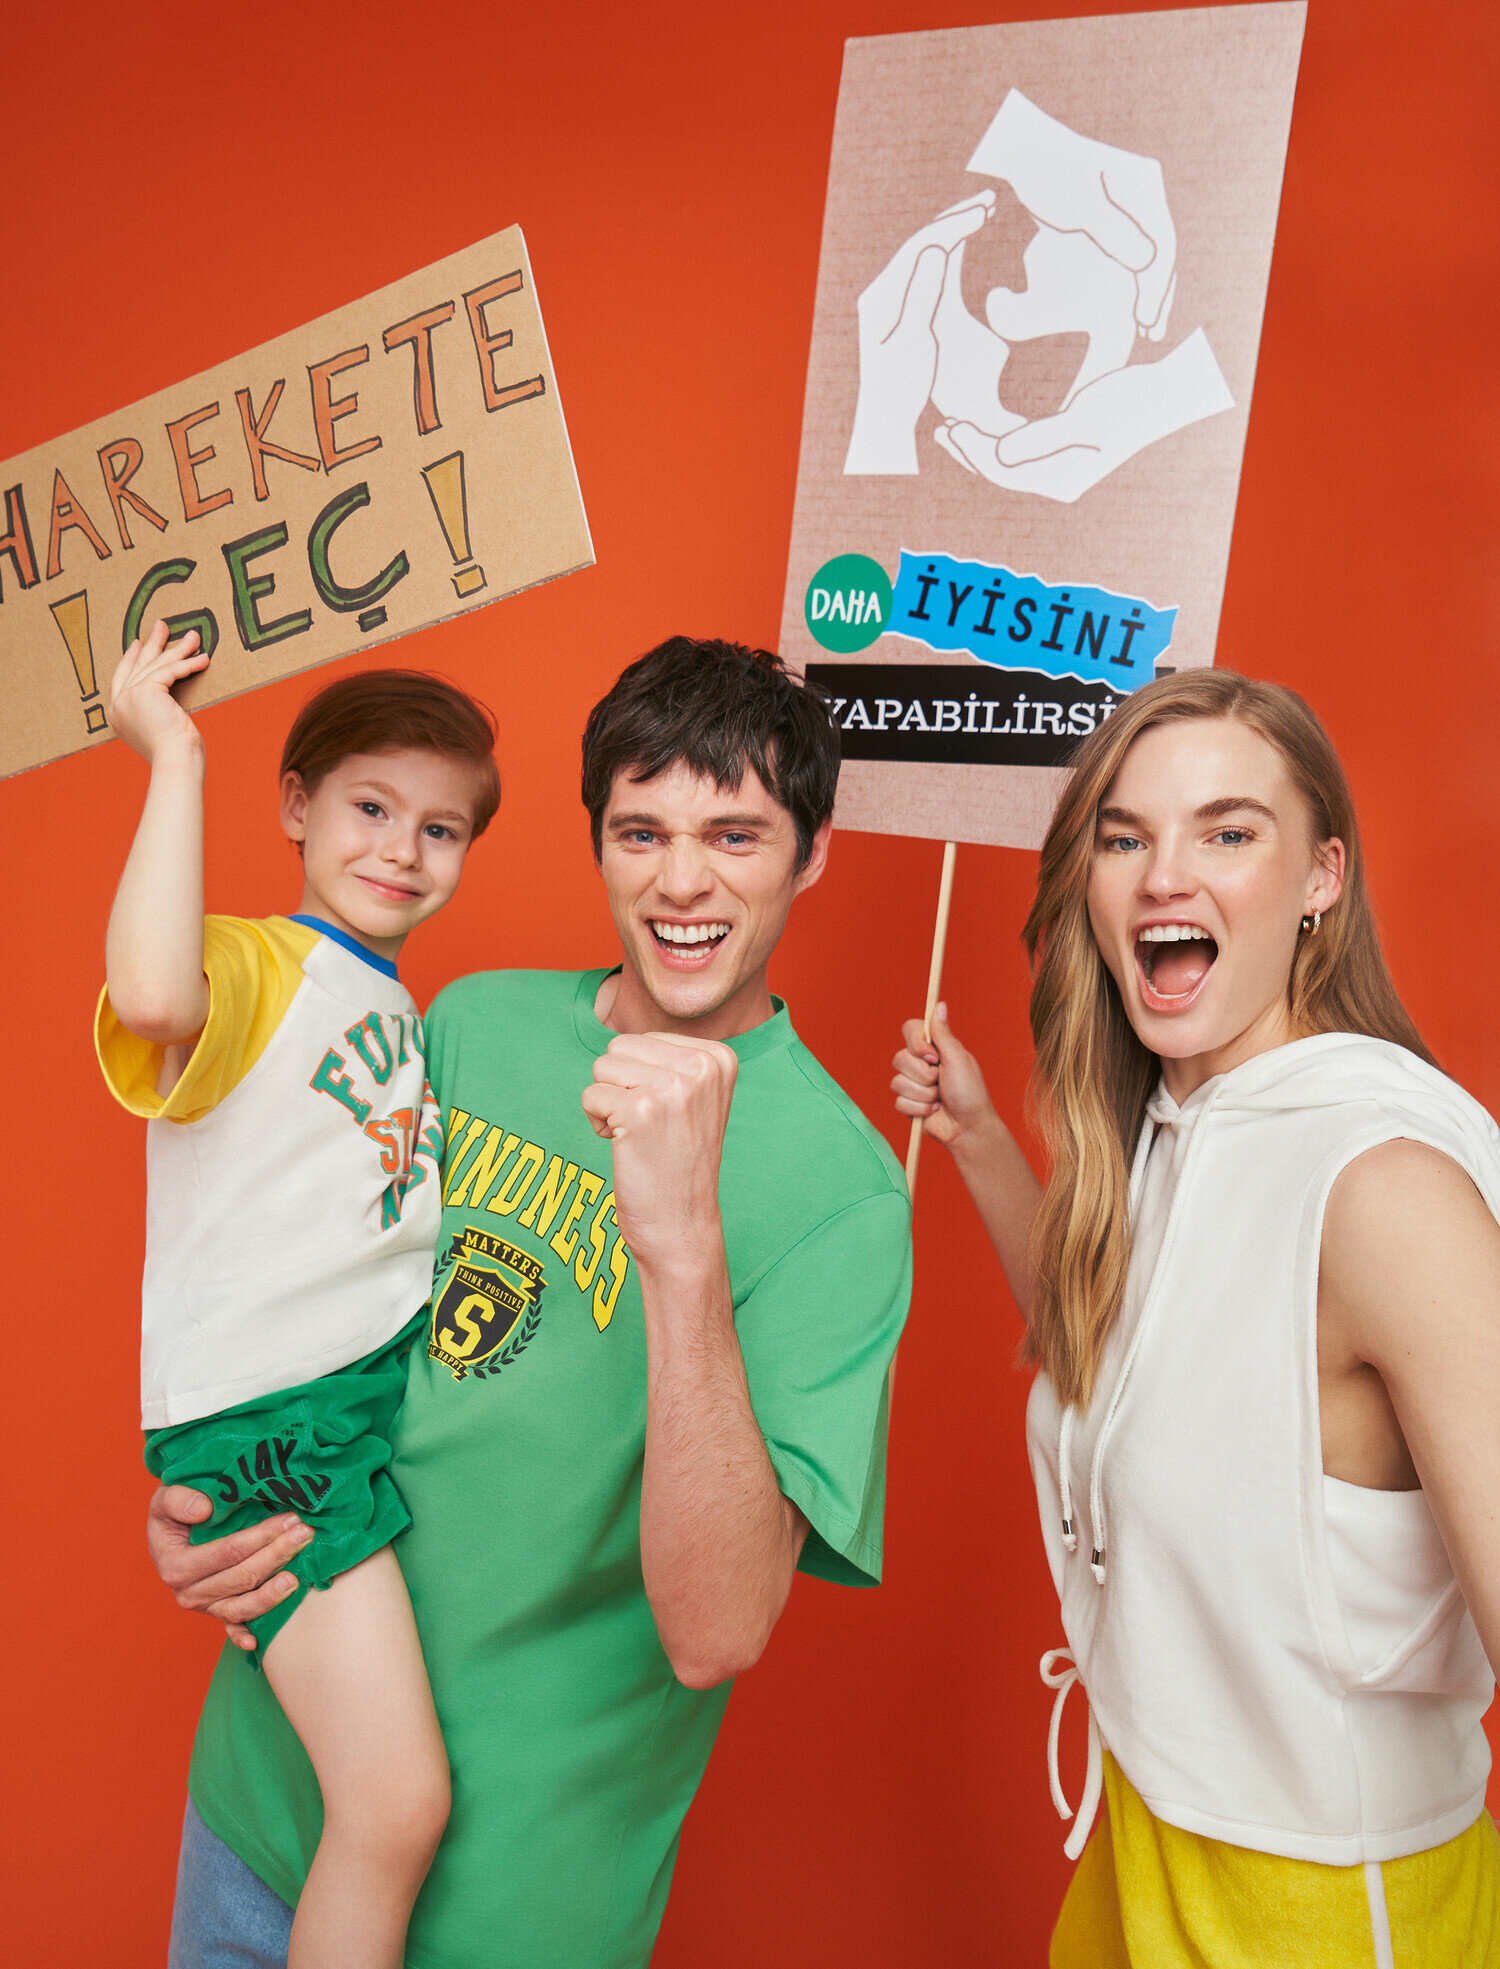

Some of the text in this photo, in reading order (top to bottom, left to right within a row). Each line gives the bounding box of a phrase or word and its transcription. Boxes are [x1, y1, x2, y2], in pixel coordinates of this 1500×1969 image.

[0, 269, 545, 604] HAREKETE
[811, 564, 1146, 668] DAHA İYİSİNİ
[824, 693, 1118, 737] APABİLİRSİ
[442, 1106, 630, 1334] INDNESS
[465, 1231, 540, 1280] MATTERS
[458, 1267, 523, 1309] THINK POSITIVE
[438, 1293, 496, 1358] S
[438, 1350, 463, 1370] HAPPY
